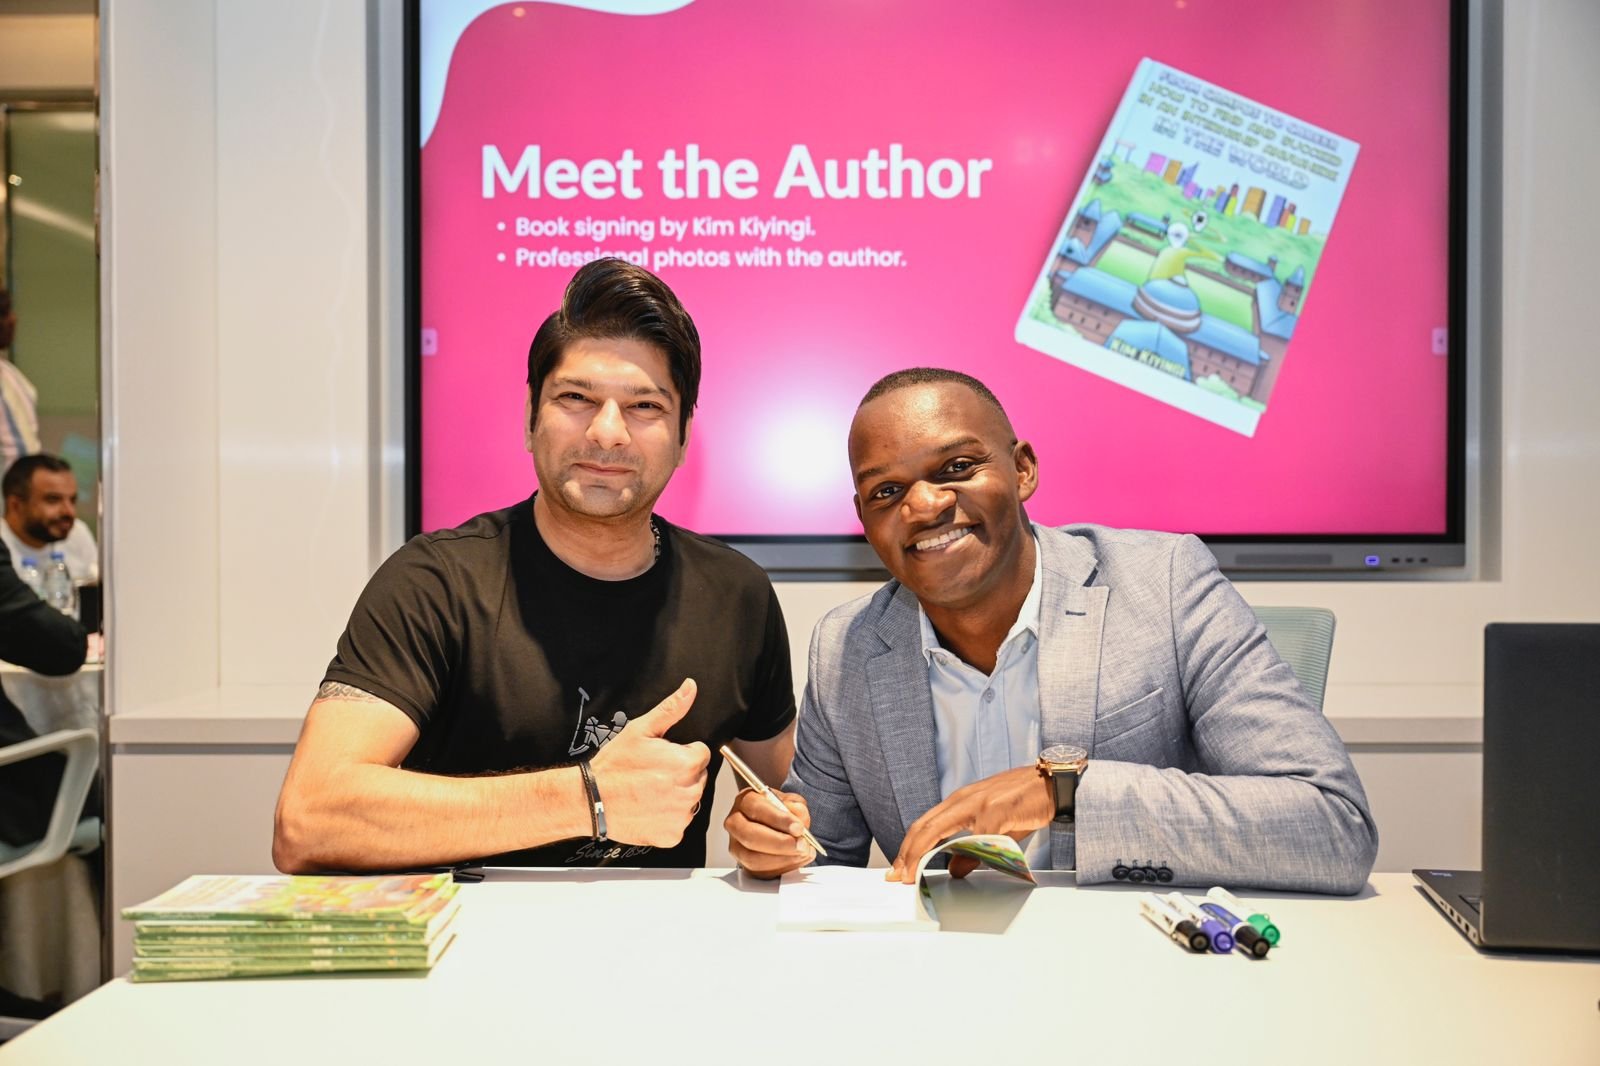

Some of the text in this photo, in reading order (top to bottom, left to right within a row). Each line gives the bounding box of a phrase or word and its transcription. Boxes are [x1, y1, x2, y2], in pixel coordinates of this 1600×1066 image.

[1188, 97, 1210, 114] TO
[480, 144, 993, 200] Meet the Author
[1228, 147, 1309, 189] WORLD
[515, 216, 816, 242] Book signing by Kim Kiyingi.
[653, 247, 731, 273] photos
[735, 247, 782, 267] with
[786, 247, 824, 267] the
[827, 247, 907, 267] author.
[565, 842, 621, 863] Since
